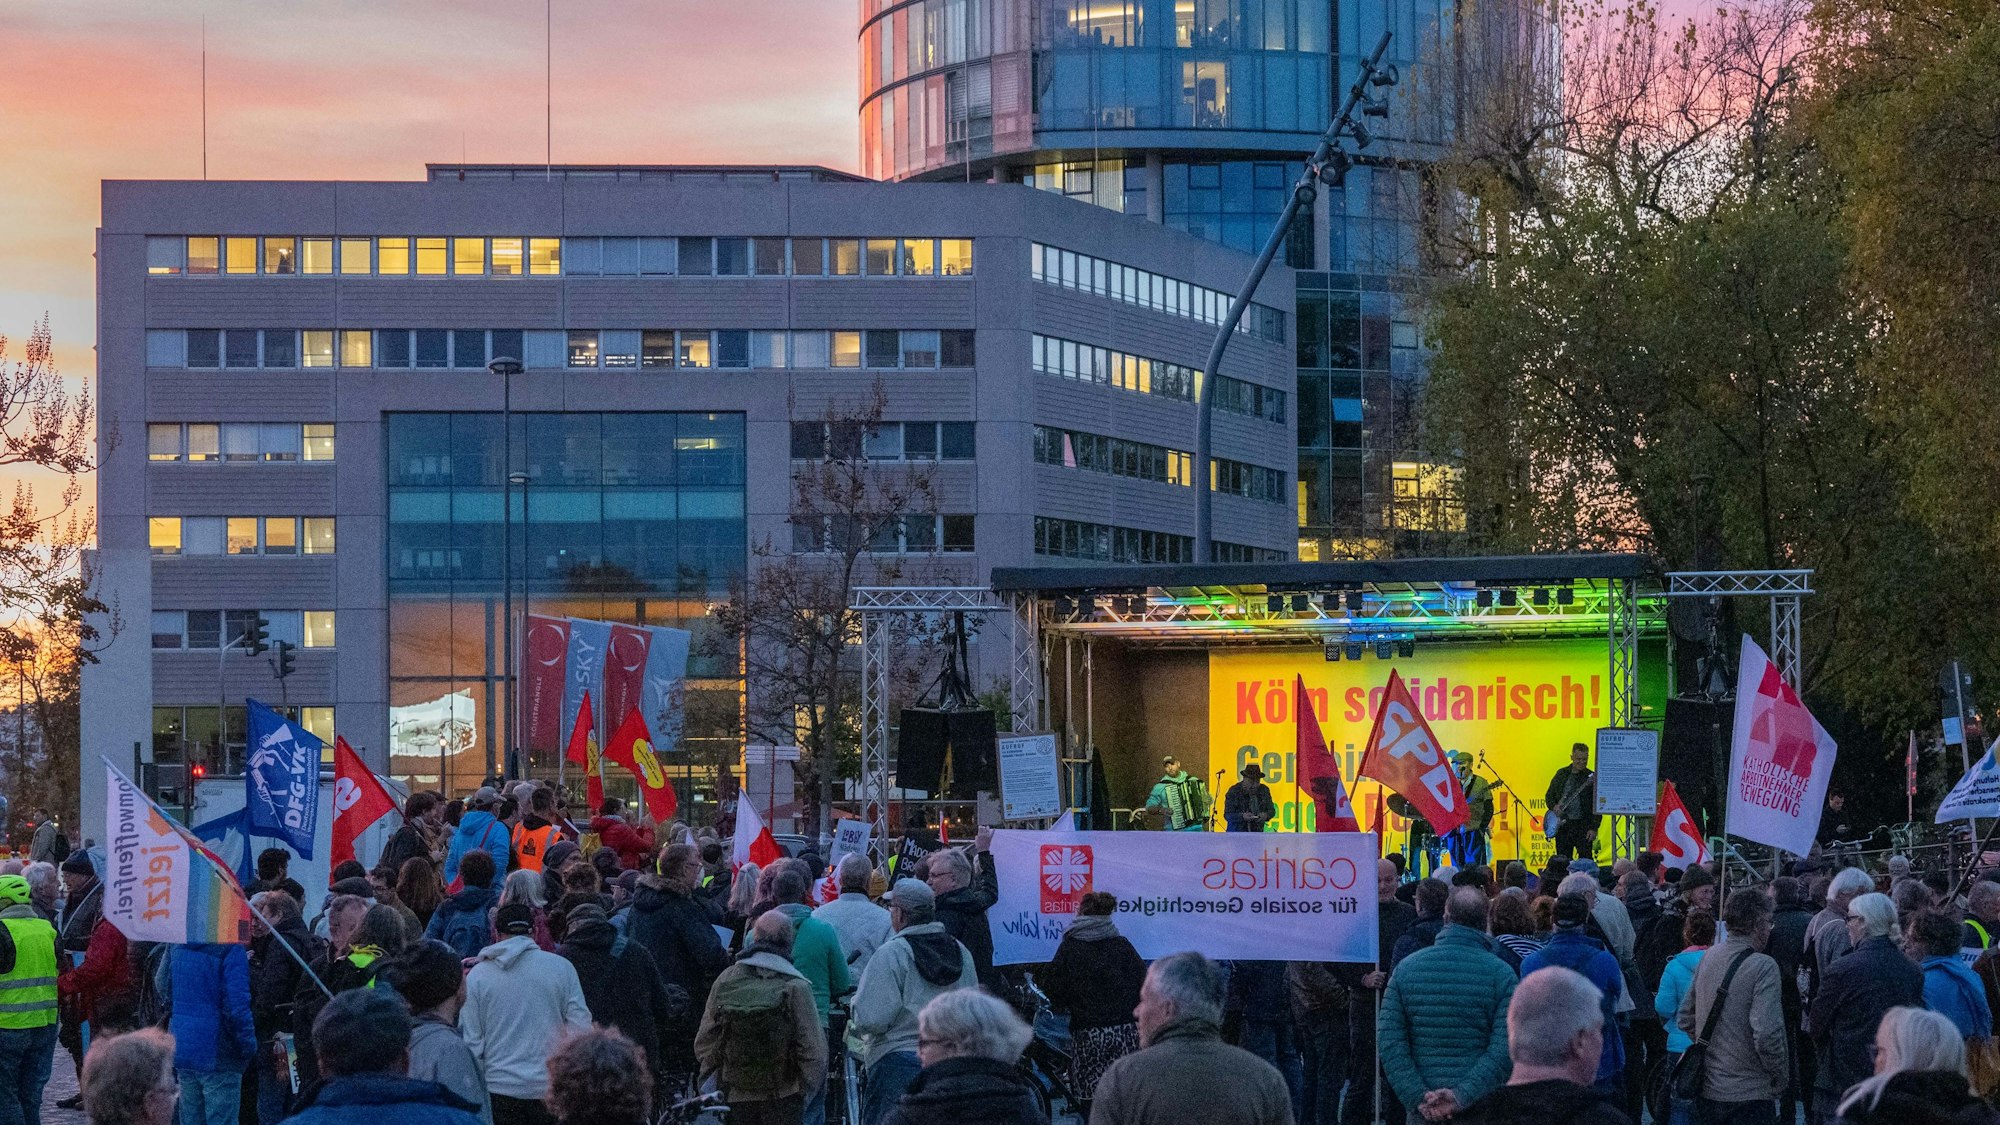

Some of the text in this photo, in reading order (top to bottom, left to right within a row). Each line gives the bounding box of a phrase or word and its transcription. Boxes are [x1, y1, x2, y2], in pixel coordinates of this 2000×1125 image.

[1236, 675, 1600, 724] Köln soidarisch!
[1379, 701, 1455, 813] SPD
[1743, 755, 1810, 793] KATHOLISCHE
[284, 741, 306, 829] DFG-VK
[1529, 799, 1546, 809] WIR
[1741, 769, 1804, 803] ARBEITNEHMER-
[1541, 842, 1554, 850] UNS
